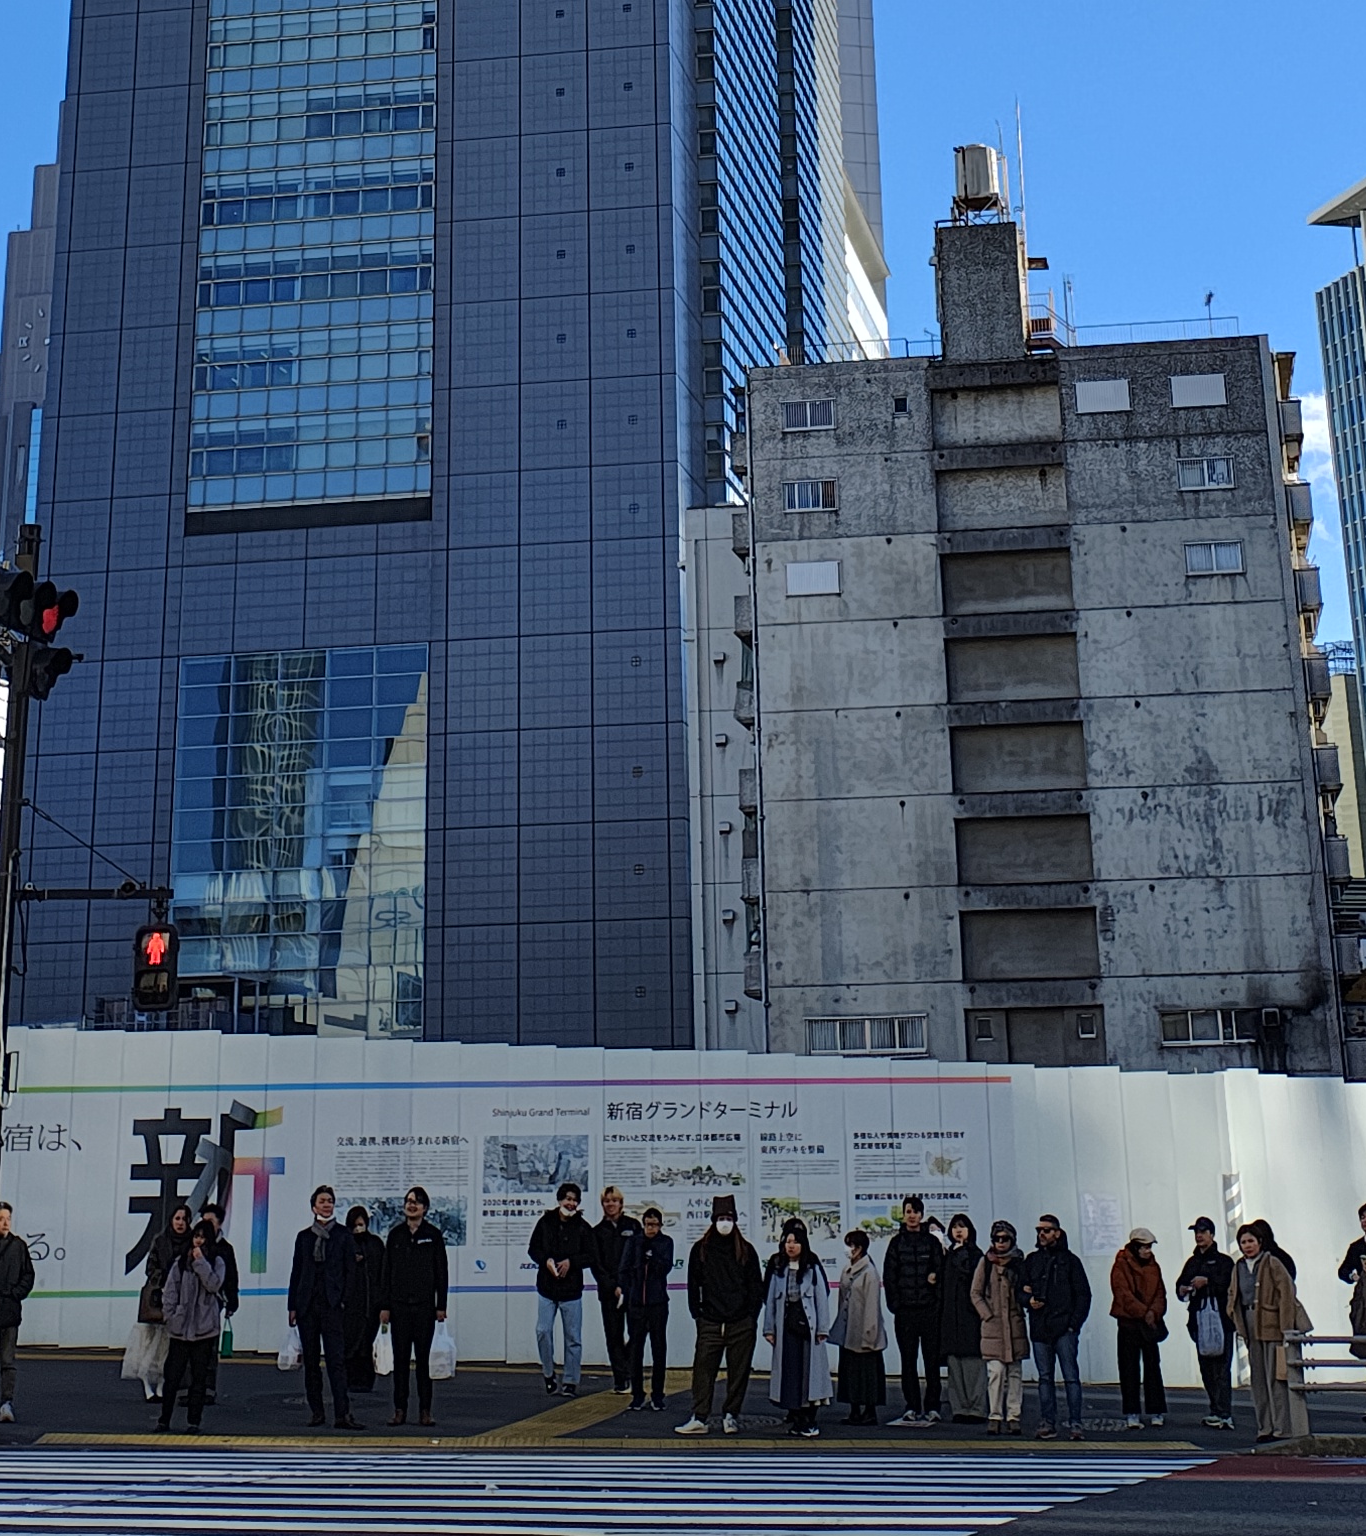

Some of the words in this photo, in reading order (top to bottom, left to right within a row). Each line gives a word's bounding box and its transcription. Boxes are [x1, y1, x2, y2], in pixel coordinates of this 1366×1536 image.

[492, 1107, 527, 1118] Shinjuku
[528, 1107, 553, 1117] Grand
[555, 1106, 590, 1116] Terminal
[607, 1101, 798, 1121] 新宿グランドターミナル
